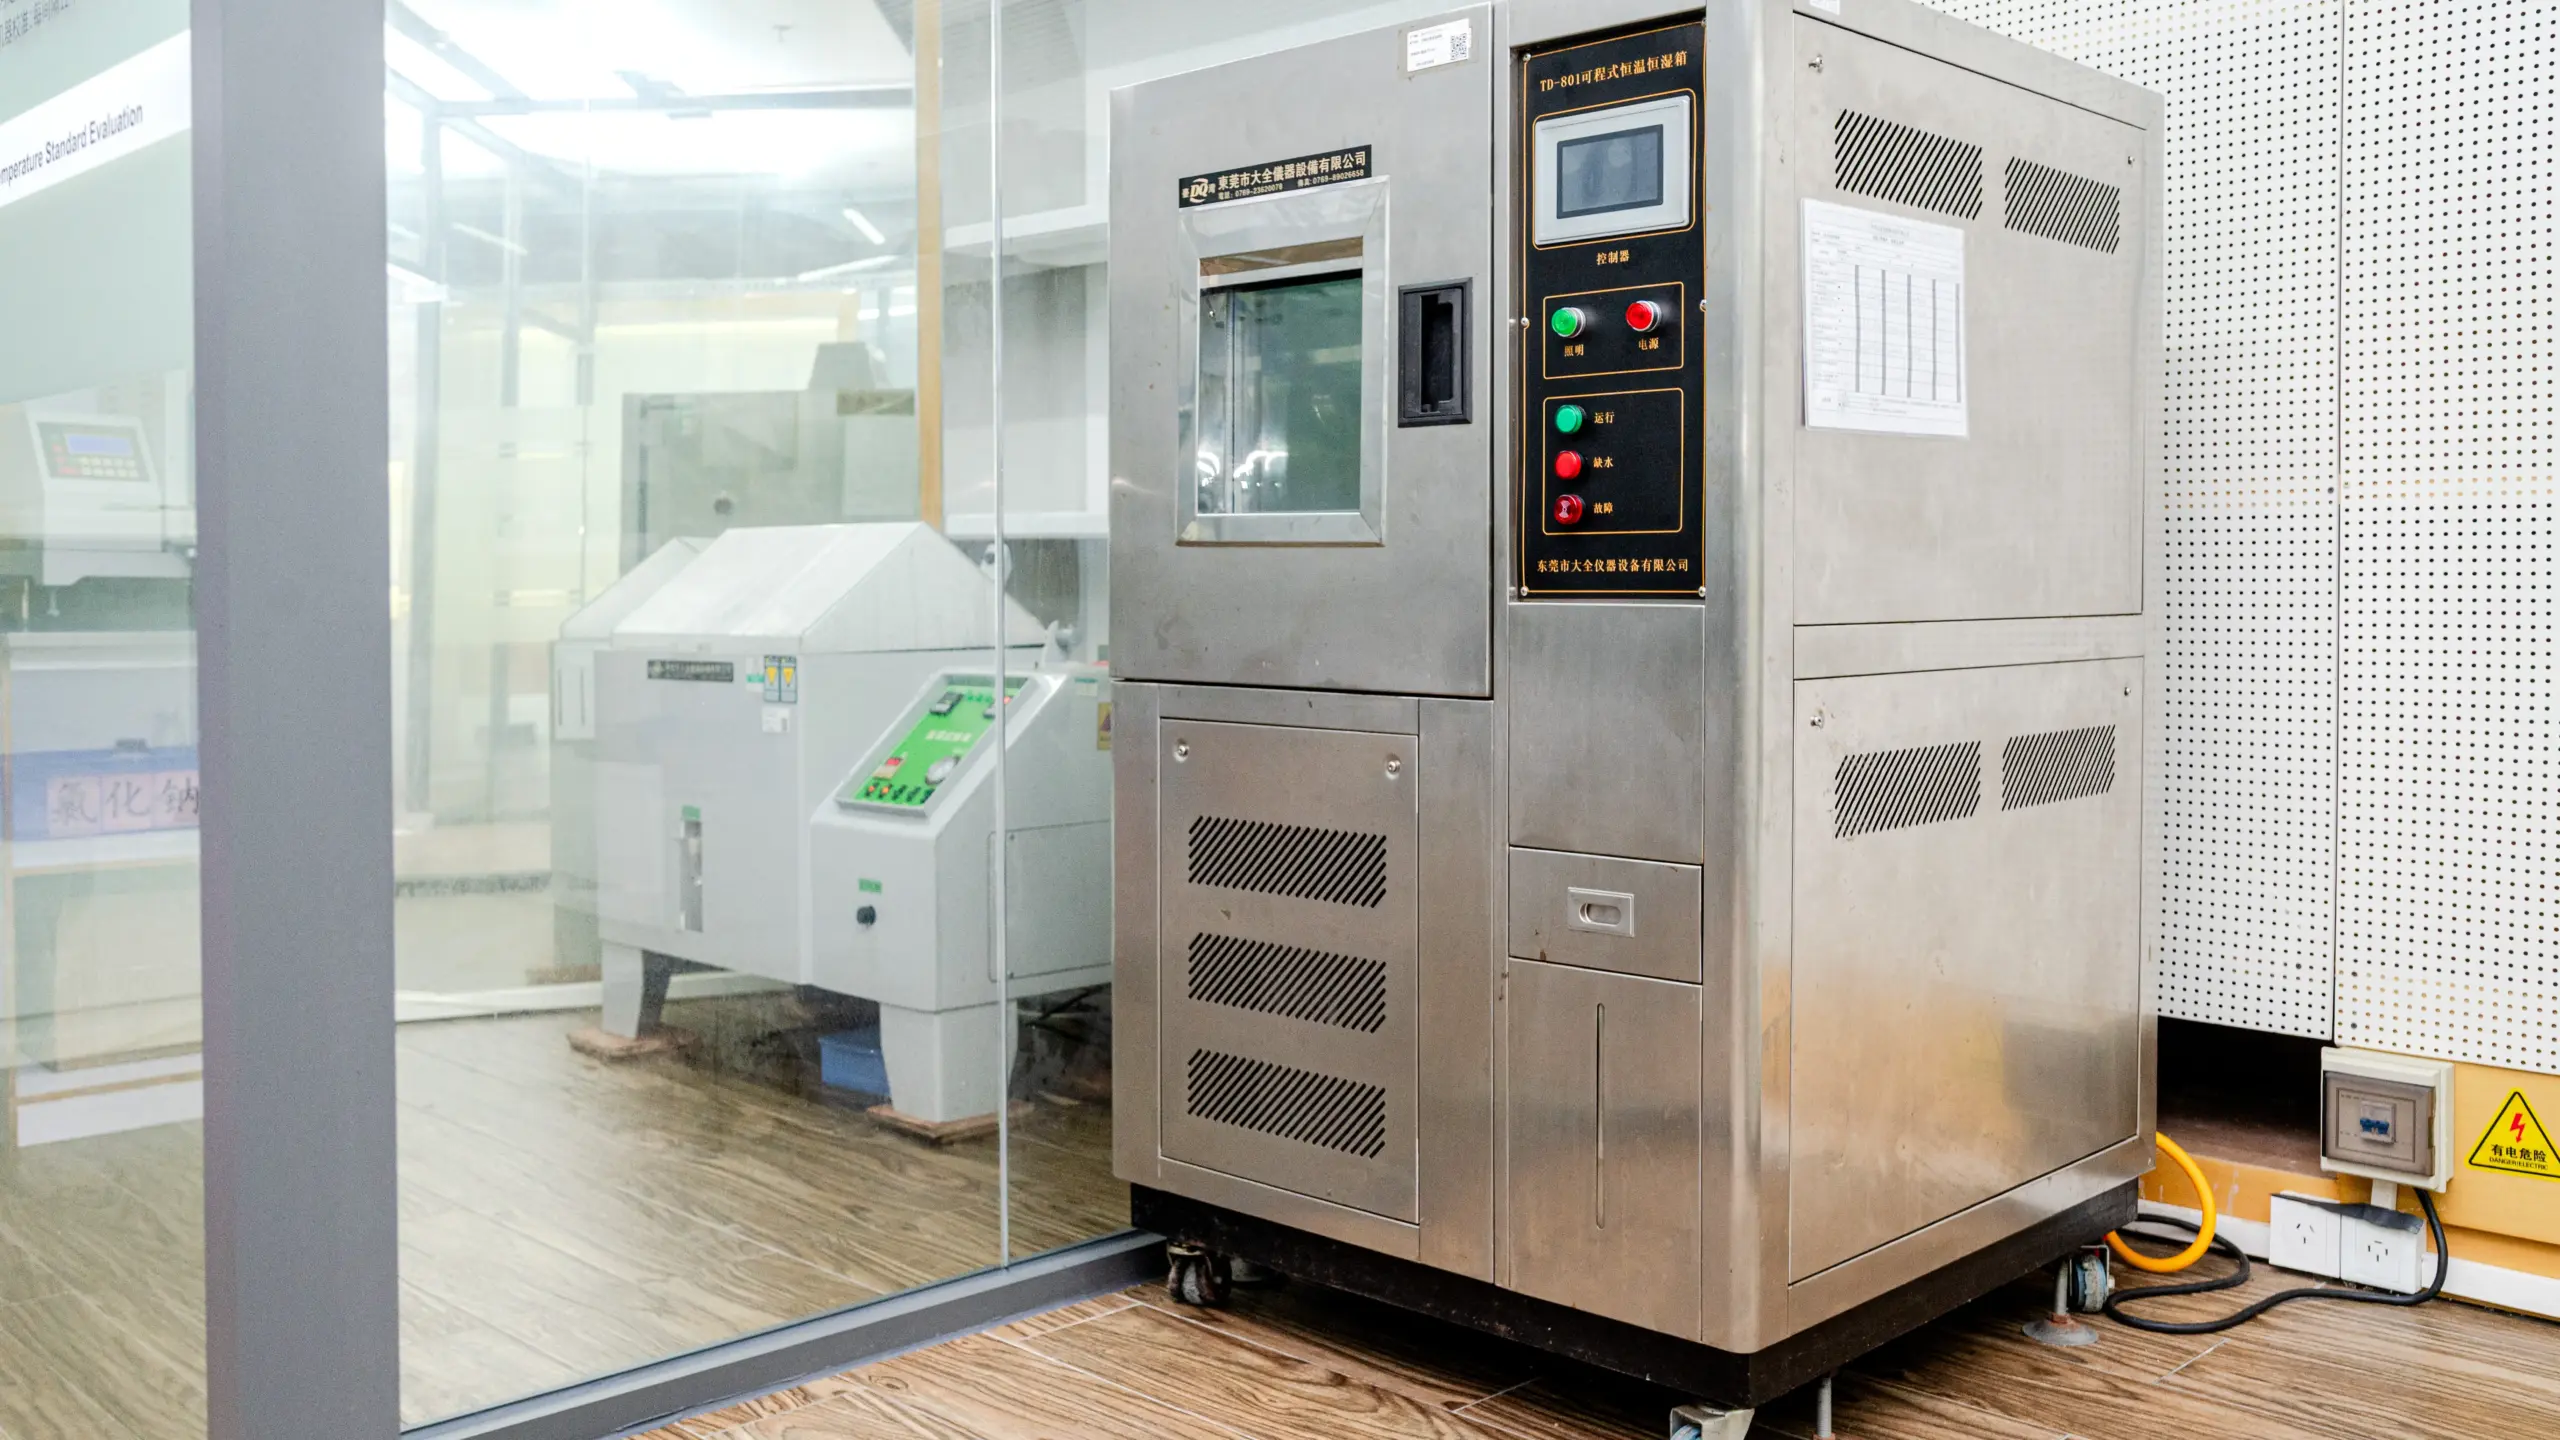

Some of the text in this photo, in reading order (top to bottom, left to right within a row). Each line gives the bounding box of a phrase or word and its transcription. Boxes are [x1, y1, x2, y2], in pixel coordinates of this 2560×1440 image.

[1540, 50, 1688, 92] TD-801可程式恒温恒湿箱
[0, 104, 143, 187] mperature Standard Evaluation
[1218, 151, 1366, 190] 東莞市大全儀器設備有限公司
[1190, 183, 1208, 198] DQ
[1596, 250, 1630, 265] 控制器
[1564, 344, 1584, 356] 照明
[1638, 338, 1659, 350] 电源
[1594, 411, 1615, 424] 运行
[1593, 457, 1613, 468] 缺水
[1593, 502, 1613, 514] 故障
[1537, 559, 1689, 572] 东莞市大全仪器设备有限公司
[2491, 1144, 2547, 1163] 有电危险
